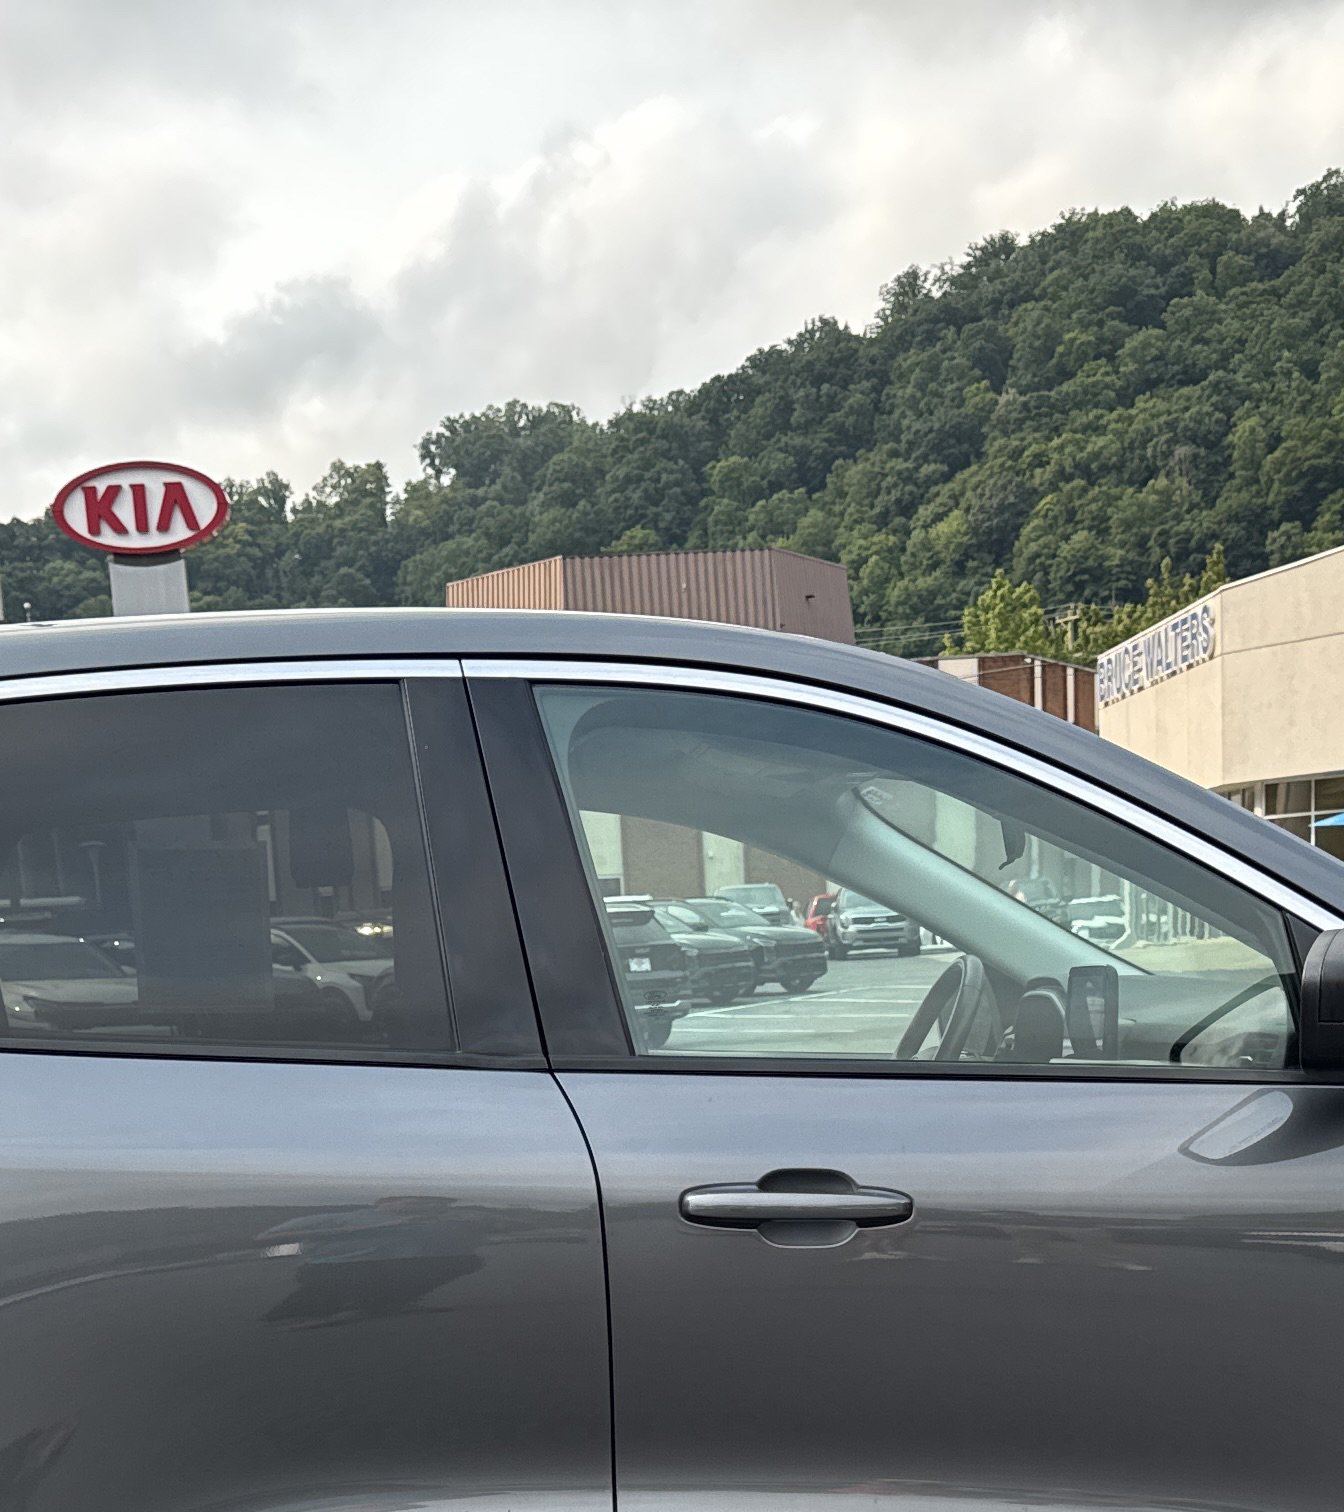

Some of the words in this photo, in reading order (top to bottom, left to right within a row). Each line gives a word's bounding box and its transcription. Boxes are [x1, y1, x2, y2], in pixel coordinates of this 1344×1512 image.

[82, 481, 201, 537] KIA
[1098, 643, 1143, 702] BRUCE
[1142, 604, 1215, 681] WALTERS
